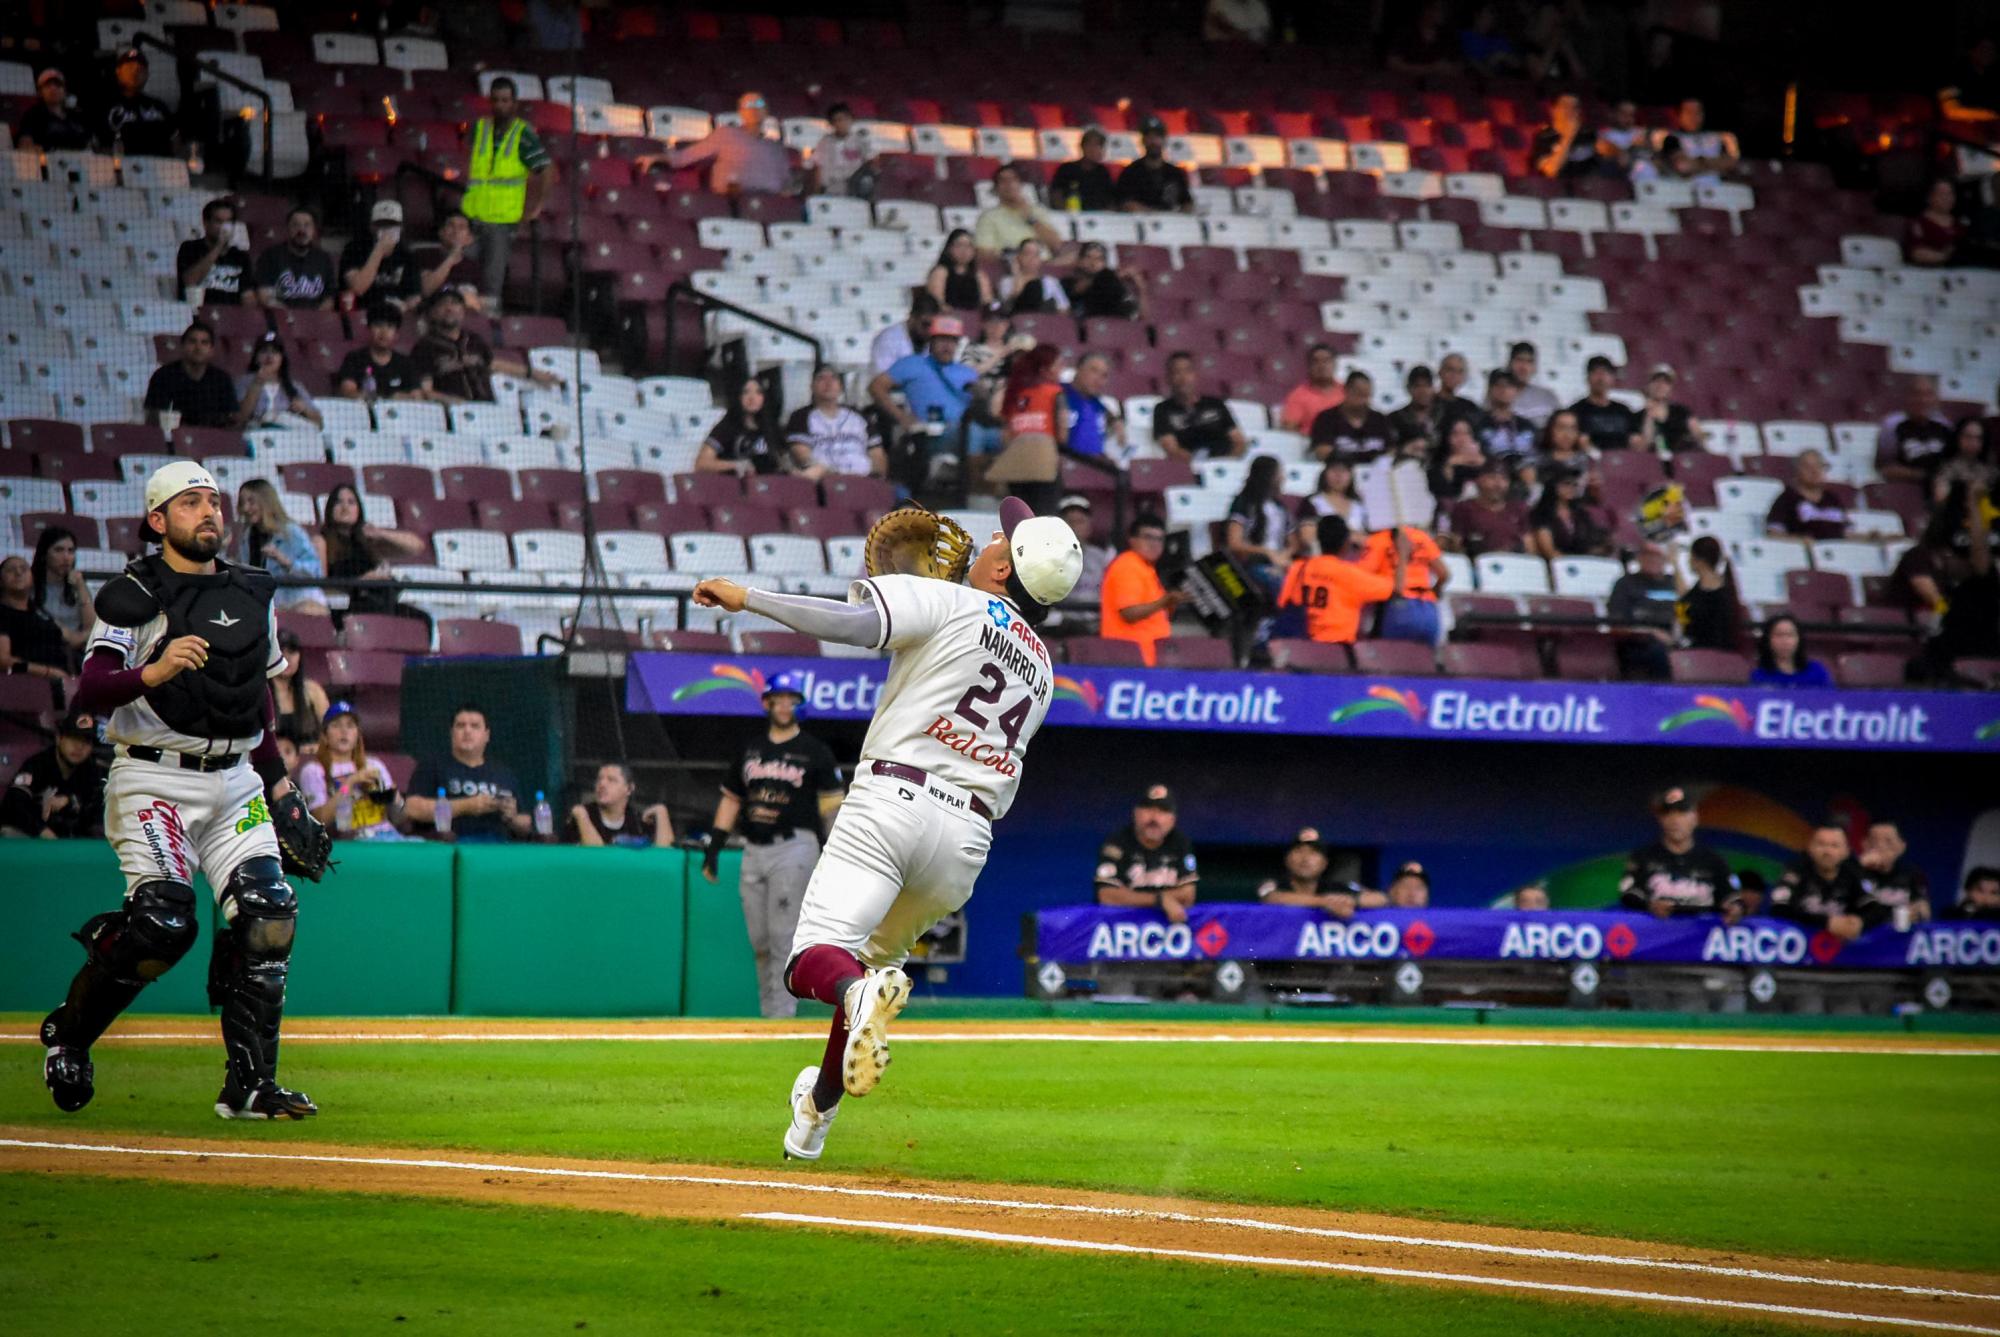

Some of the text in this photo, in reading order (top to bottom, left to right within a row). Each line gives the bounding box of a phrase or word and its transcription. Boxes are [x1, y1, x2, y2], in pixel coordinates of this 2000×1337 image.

[979, 623, 1048, 706] NAVARRO JR
[1010, 621, 1049, 670] ARIEL
[954, 662, 1033, 749] 24
[1105, 680, 1283, 724] Electrolit
[1429, 689, 1606, 733] Electrolit
[1755, 700, 1929, 743] Electrolit
[928, 785, 966, 810] NEW PLAY
[1087, 921, 1192, 958] ARCO
[1296, 921, 1400, 958] ARCO
[1499, 922, 1603, 959] ARCO
[1702, 925, 1807, 964] ARCO
[1905, 929, 2000, 966] ARCO
